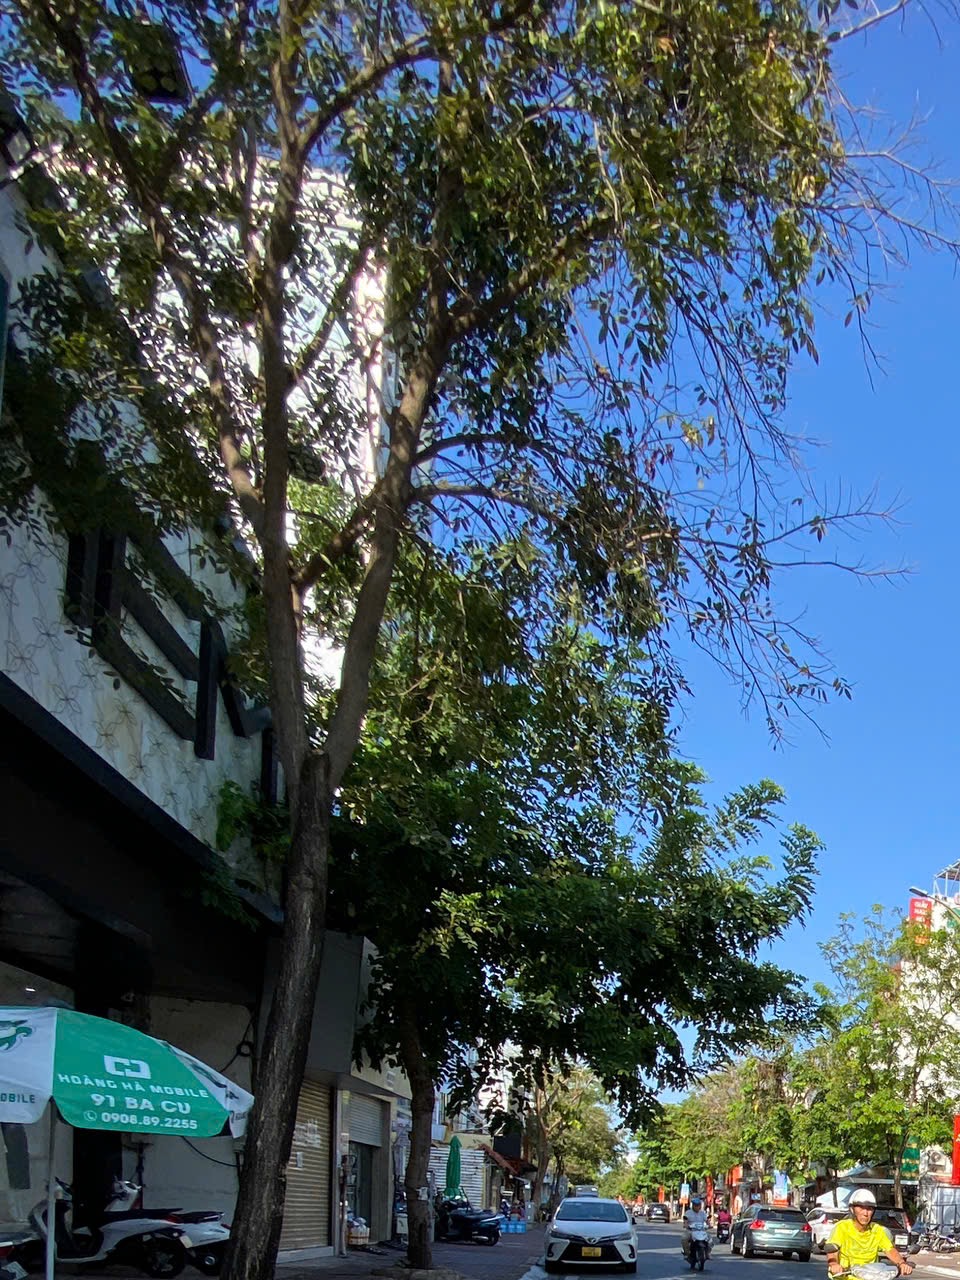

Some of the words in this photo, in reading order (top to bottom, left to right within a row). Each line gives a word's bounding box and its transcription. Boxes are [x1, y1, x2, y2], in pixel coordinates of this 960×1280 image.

[57, 1073, 117, 1089] HOÀNG
[123, 1081, 146, 1092] HÀ
[150, 1084, 209, 1098] MOBILE
[125, 1096, 155, 1112] BA
[160, 1100, 191, 1115] CU
[101, 1112, 198, 1130] 0908.89.2255
